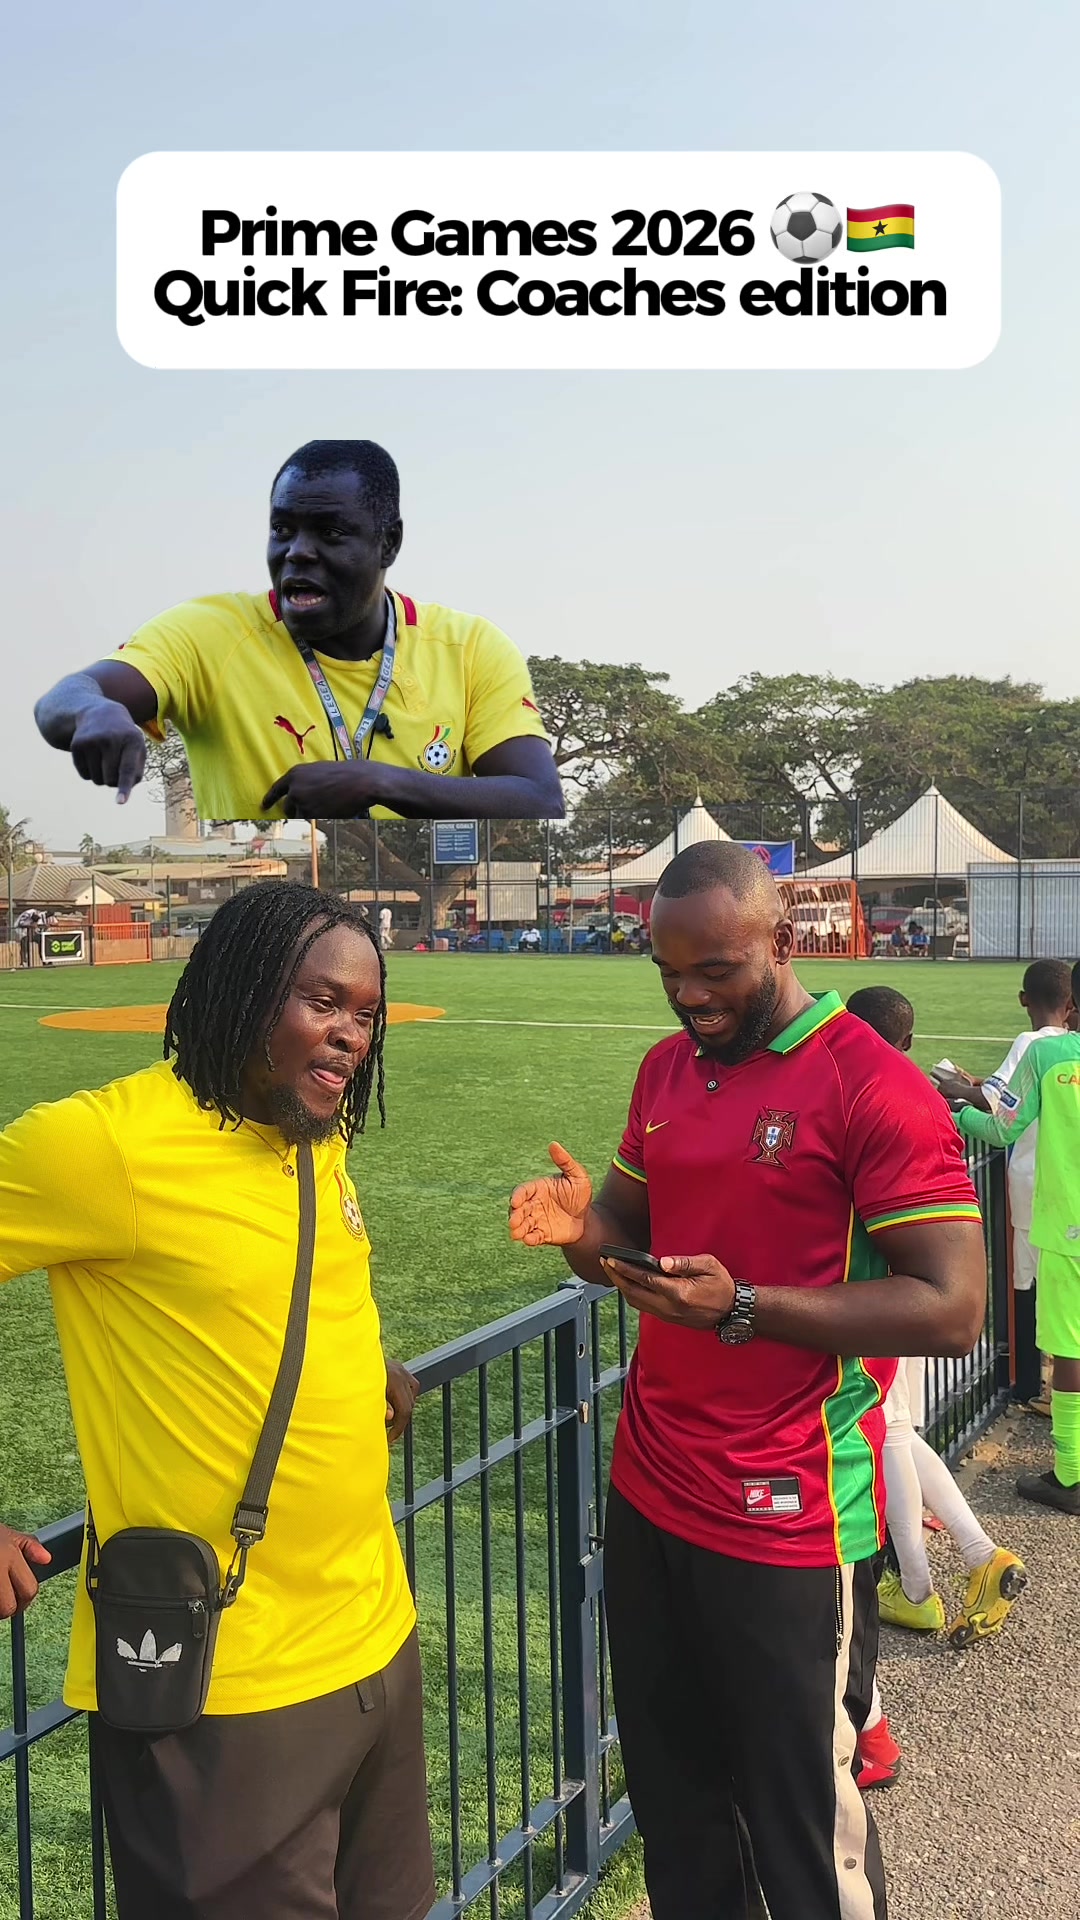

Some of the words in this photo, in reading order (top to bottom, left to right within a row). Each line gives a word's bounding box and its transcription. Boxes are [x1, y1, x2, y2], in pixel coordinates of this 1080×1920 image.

[378, 655, 393, 689] LEGEA
[316, 679, 338, 715] LEGEA
[749, 1489, 764, 1498] NIKE
